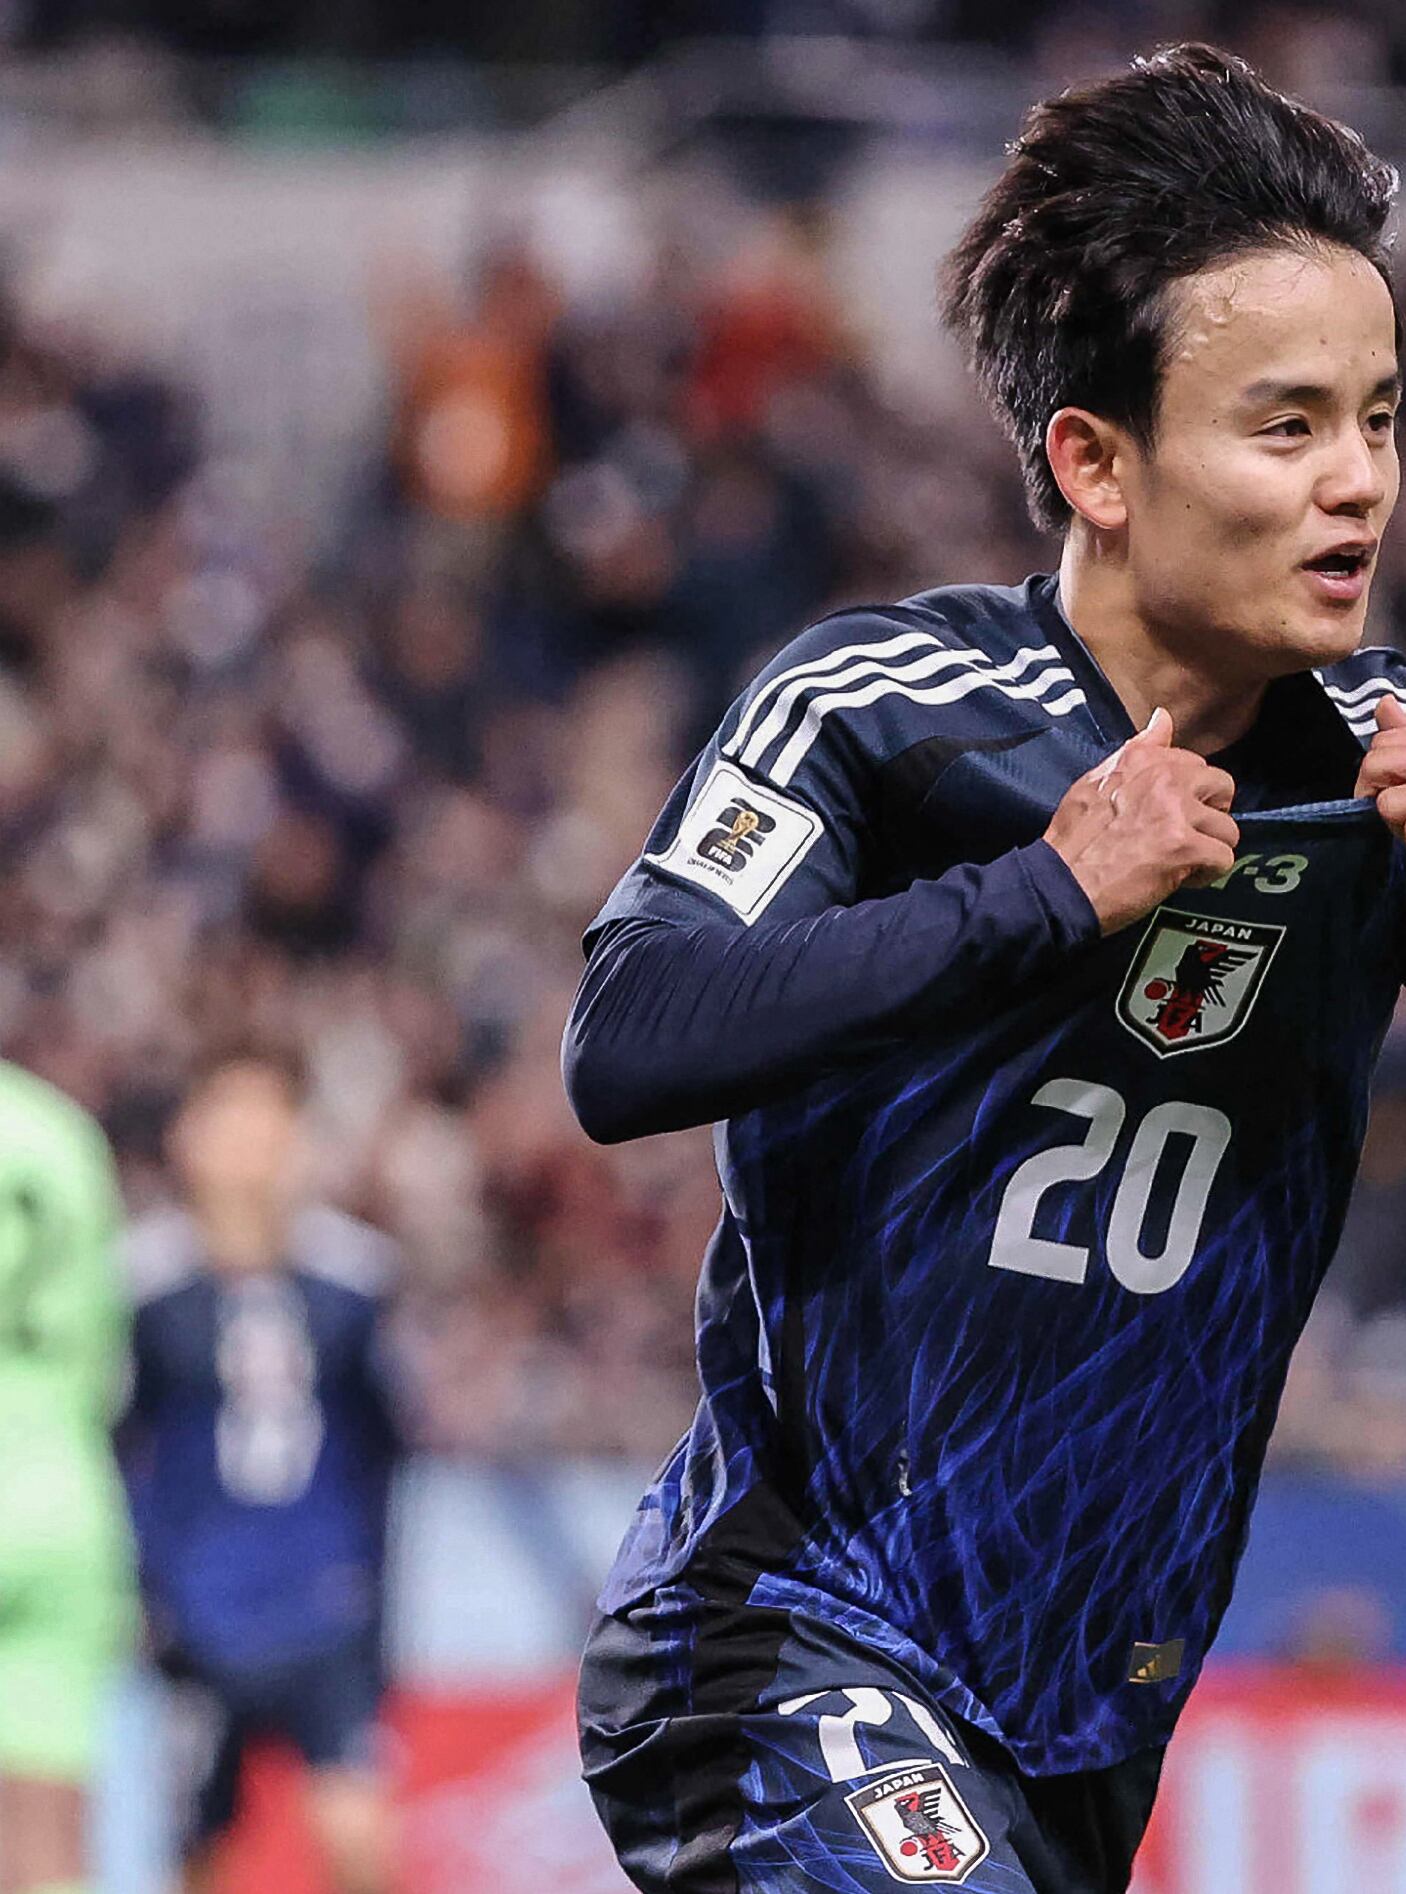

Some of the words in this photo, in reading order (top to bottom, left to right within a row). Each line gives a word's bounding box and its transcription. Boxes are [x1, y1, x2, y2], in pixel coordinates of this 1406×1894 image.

[707, 846, 733, 865] FIFA
[1185, 918, 1253, 941] JAPAN
[987, 1077, 1232, 1295] 20
[874, 1772, 925, 1800] JAPAN
